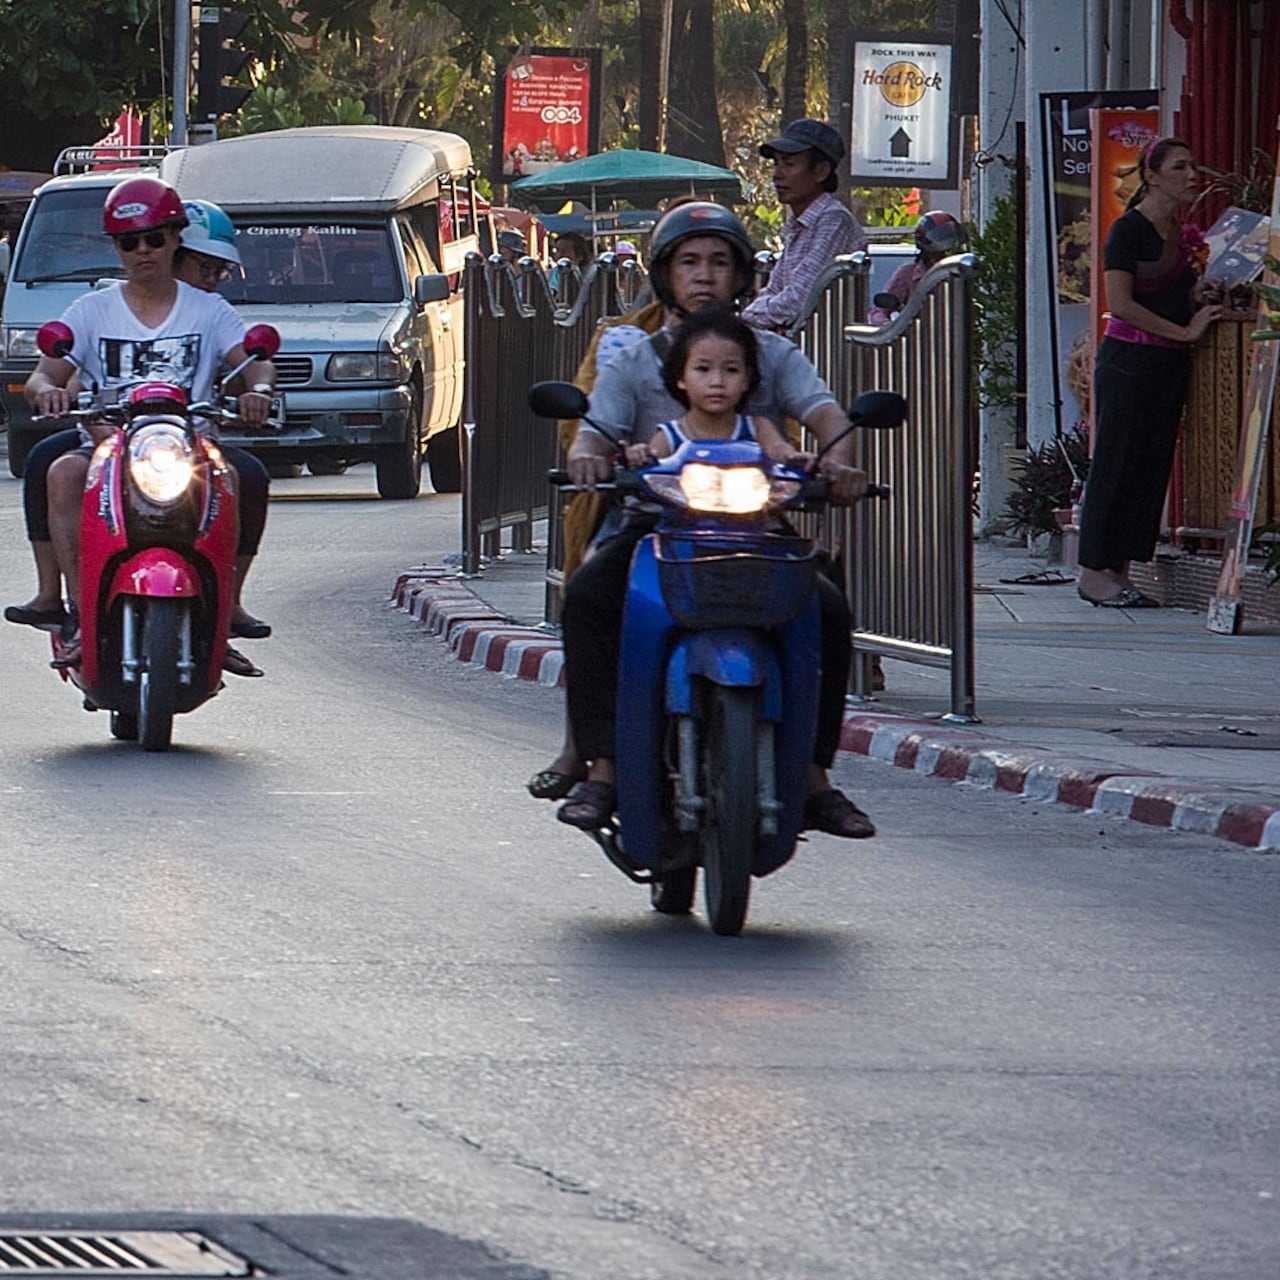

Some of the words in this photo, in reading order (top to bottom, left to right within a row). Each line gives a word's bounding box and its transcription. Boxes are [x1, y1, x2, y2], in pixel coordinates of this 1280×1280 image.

[862, 68, 902, 86] Hard
[904, 70, 943, 91] Rock
[542, 107, 582, 124] 004
[246, 224, 302, 237] Chang
[308, 224, 357, 236] Kalim
